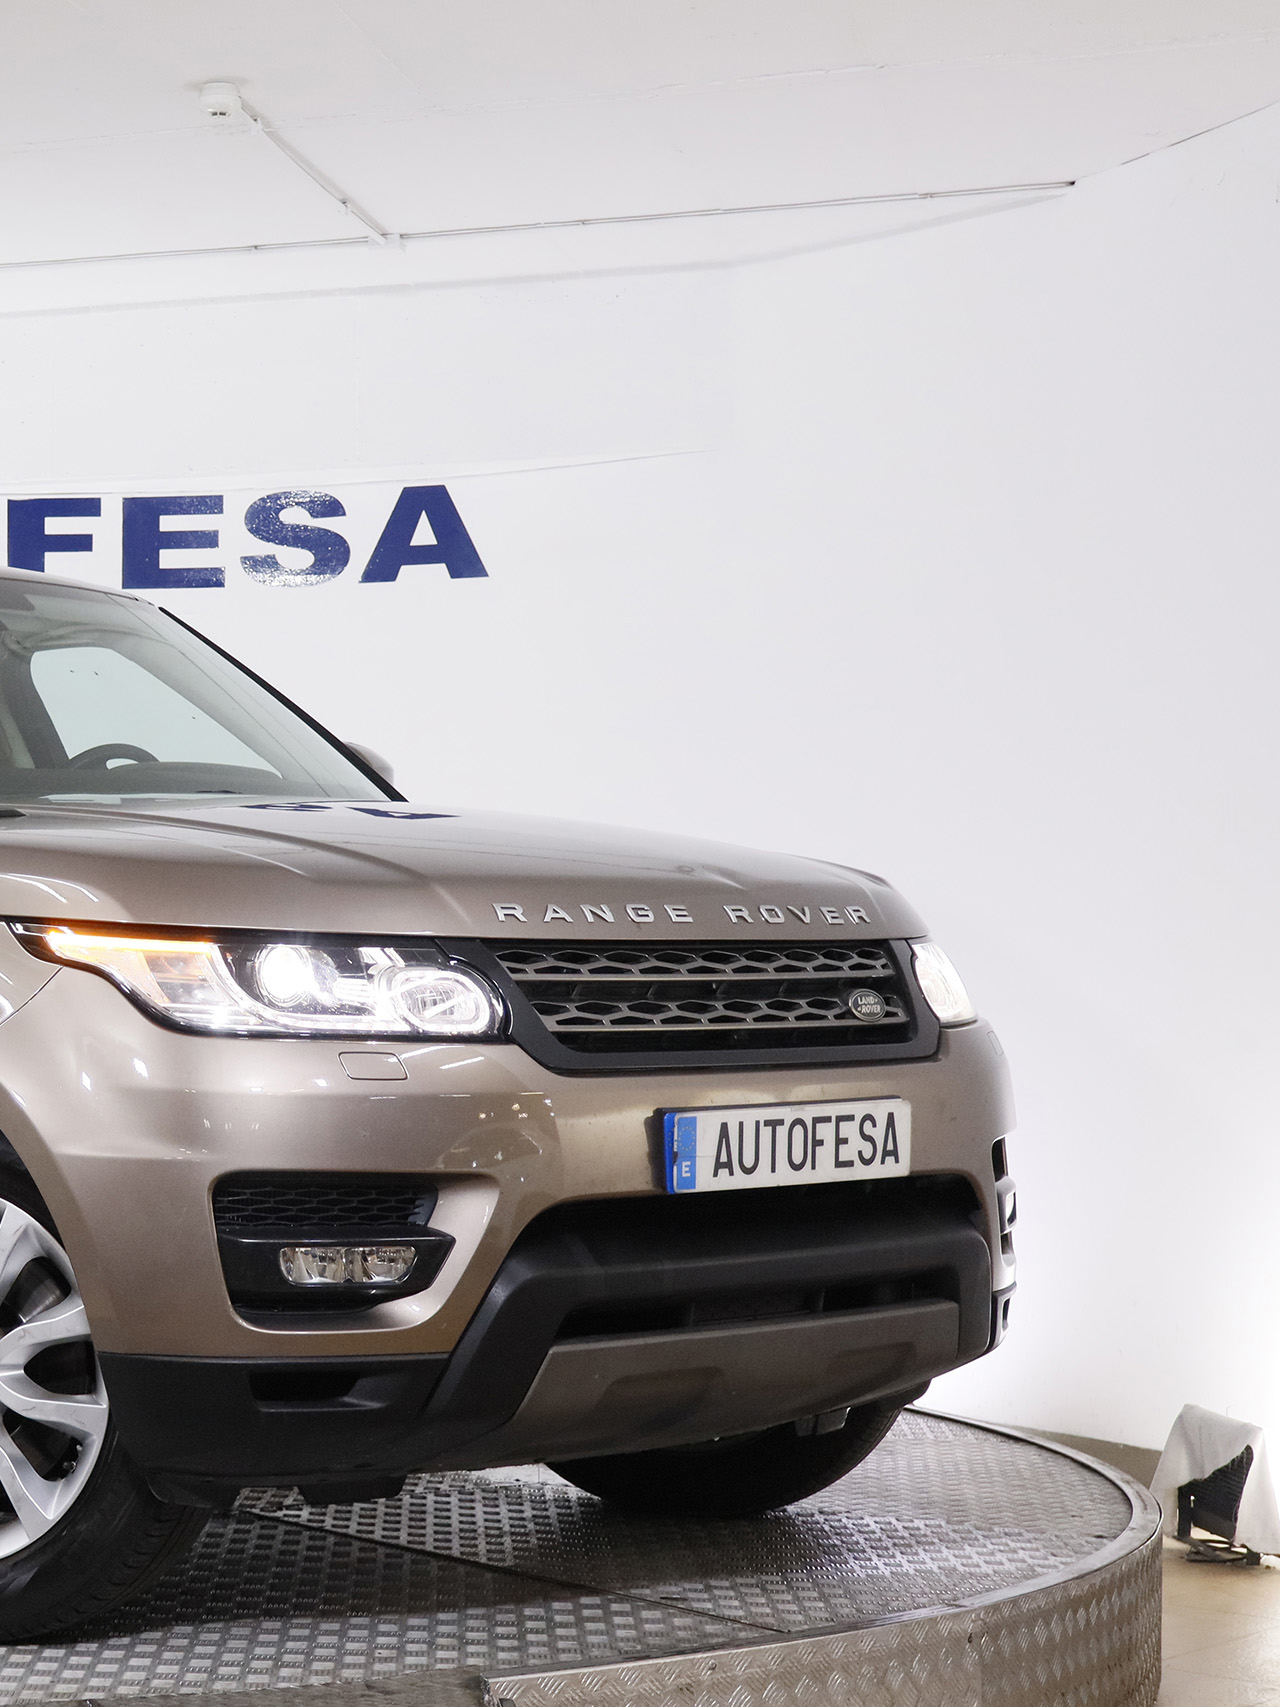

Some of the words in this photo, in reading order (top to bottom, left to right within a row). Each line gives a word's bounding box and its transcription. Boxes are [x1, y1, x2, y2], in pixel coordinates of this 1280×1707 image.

[491, 902, 694, 924] RANGE
[722, 904, 871, 925] ROVER
[857, 996, 875, 1005] LAND
[860, 1004, 881, 1014] ROVER
[712, 1111, 901, 1178] AUTOFESA
[680, 1160, 692, 1177] E
